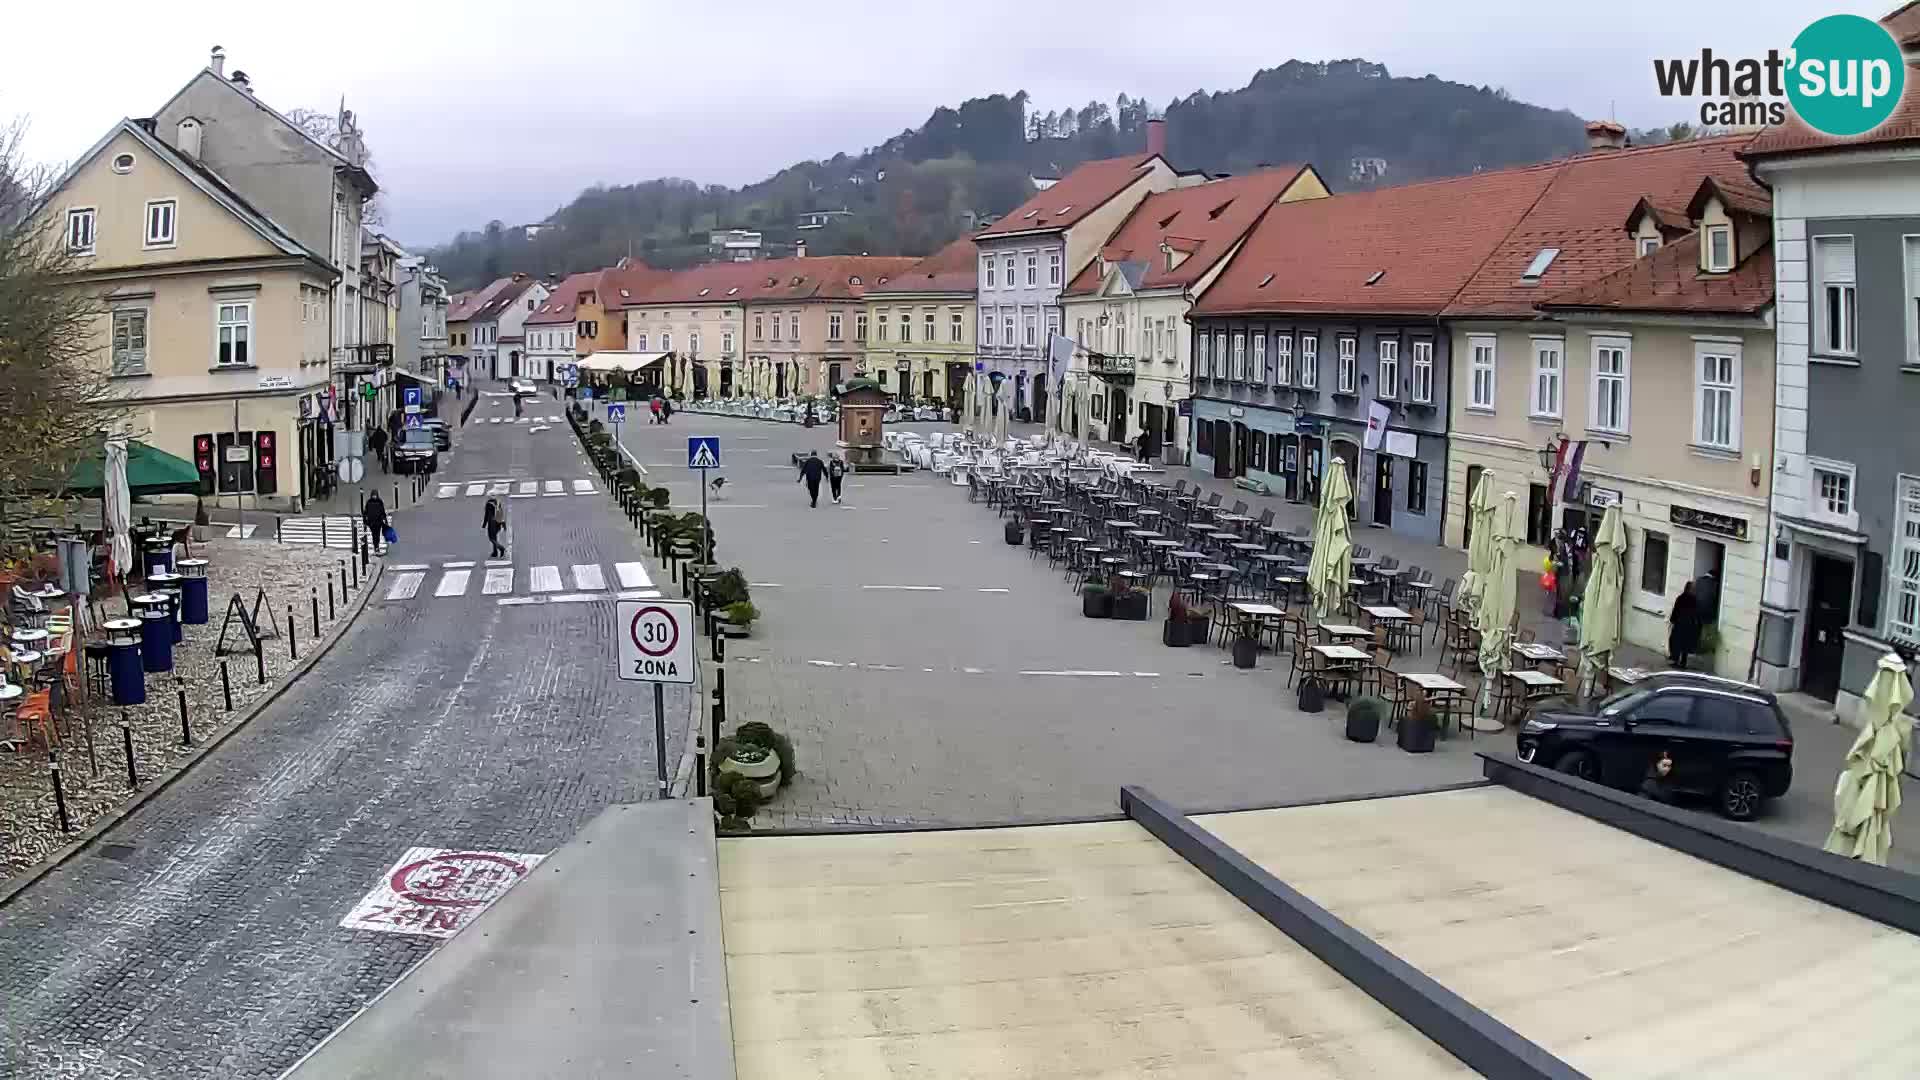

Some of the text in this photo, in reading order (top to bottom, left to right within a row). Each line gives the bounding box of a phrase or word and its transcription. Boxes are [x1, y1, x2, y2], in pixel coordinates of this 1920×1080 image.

[408, 392, 416, 403] P
[643, 622, 667, 643] 30
[634, 660, 678, 676] ZONA
